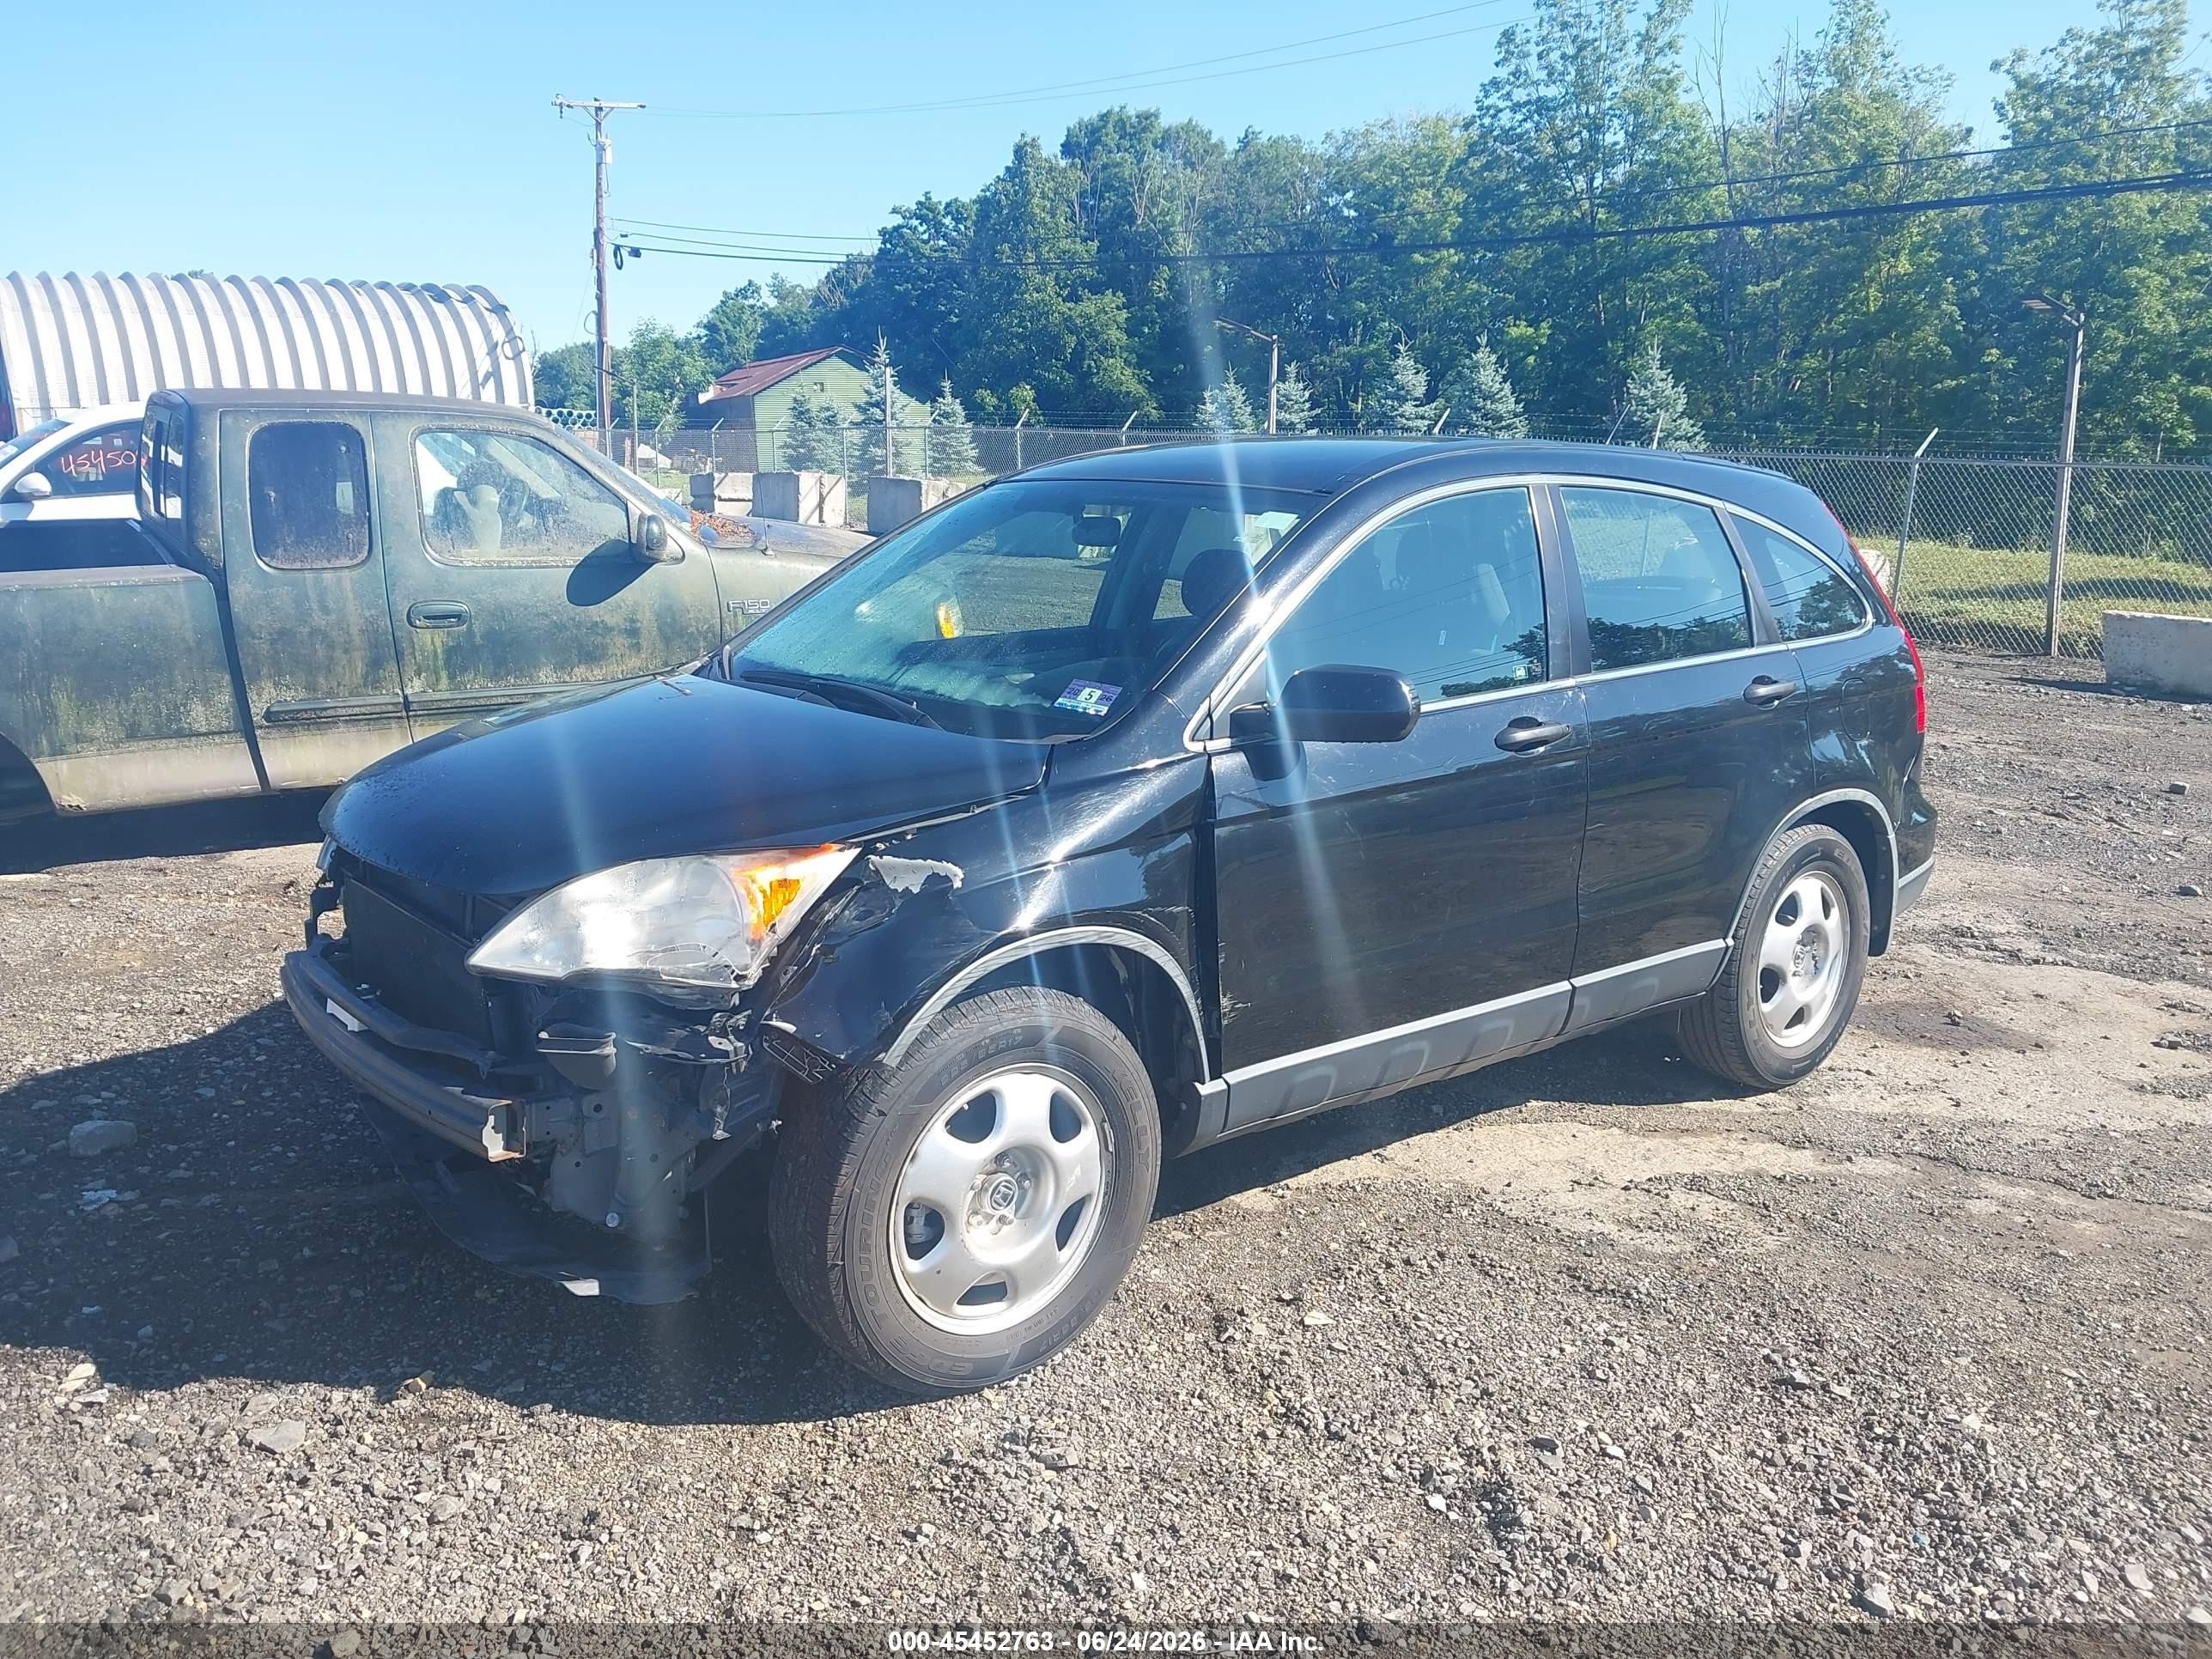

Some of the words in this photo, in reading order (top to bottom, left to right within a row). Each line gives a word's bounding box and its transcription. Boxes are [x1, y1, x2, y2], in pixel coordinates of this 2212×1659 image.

[1085, 690, 1097, 701] 5
[1103, 1064, 1151, 1174] KELLY
[858, 1152, 892, 1331] TOURING
[889, 1334, 974, 1376] EDGE
